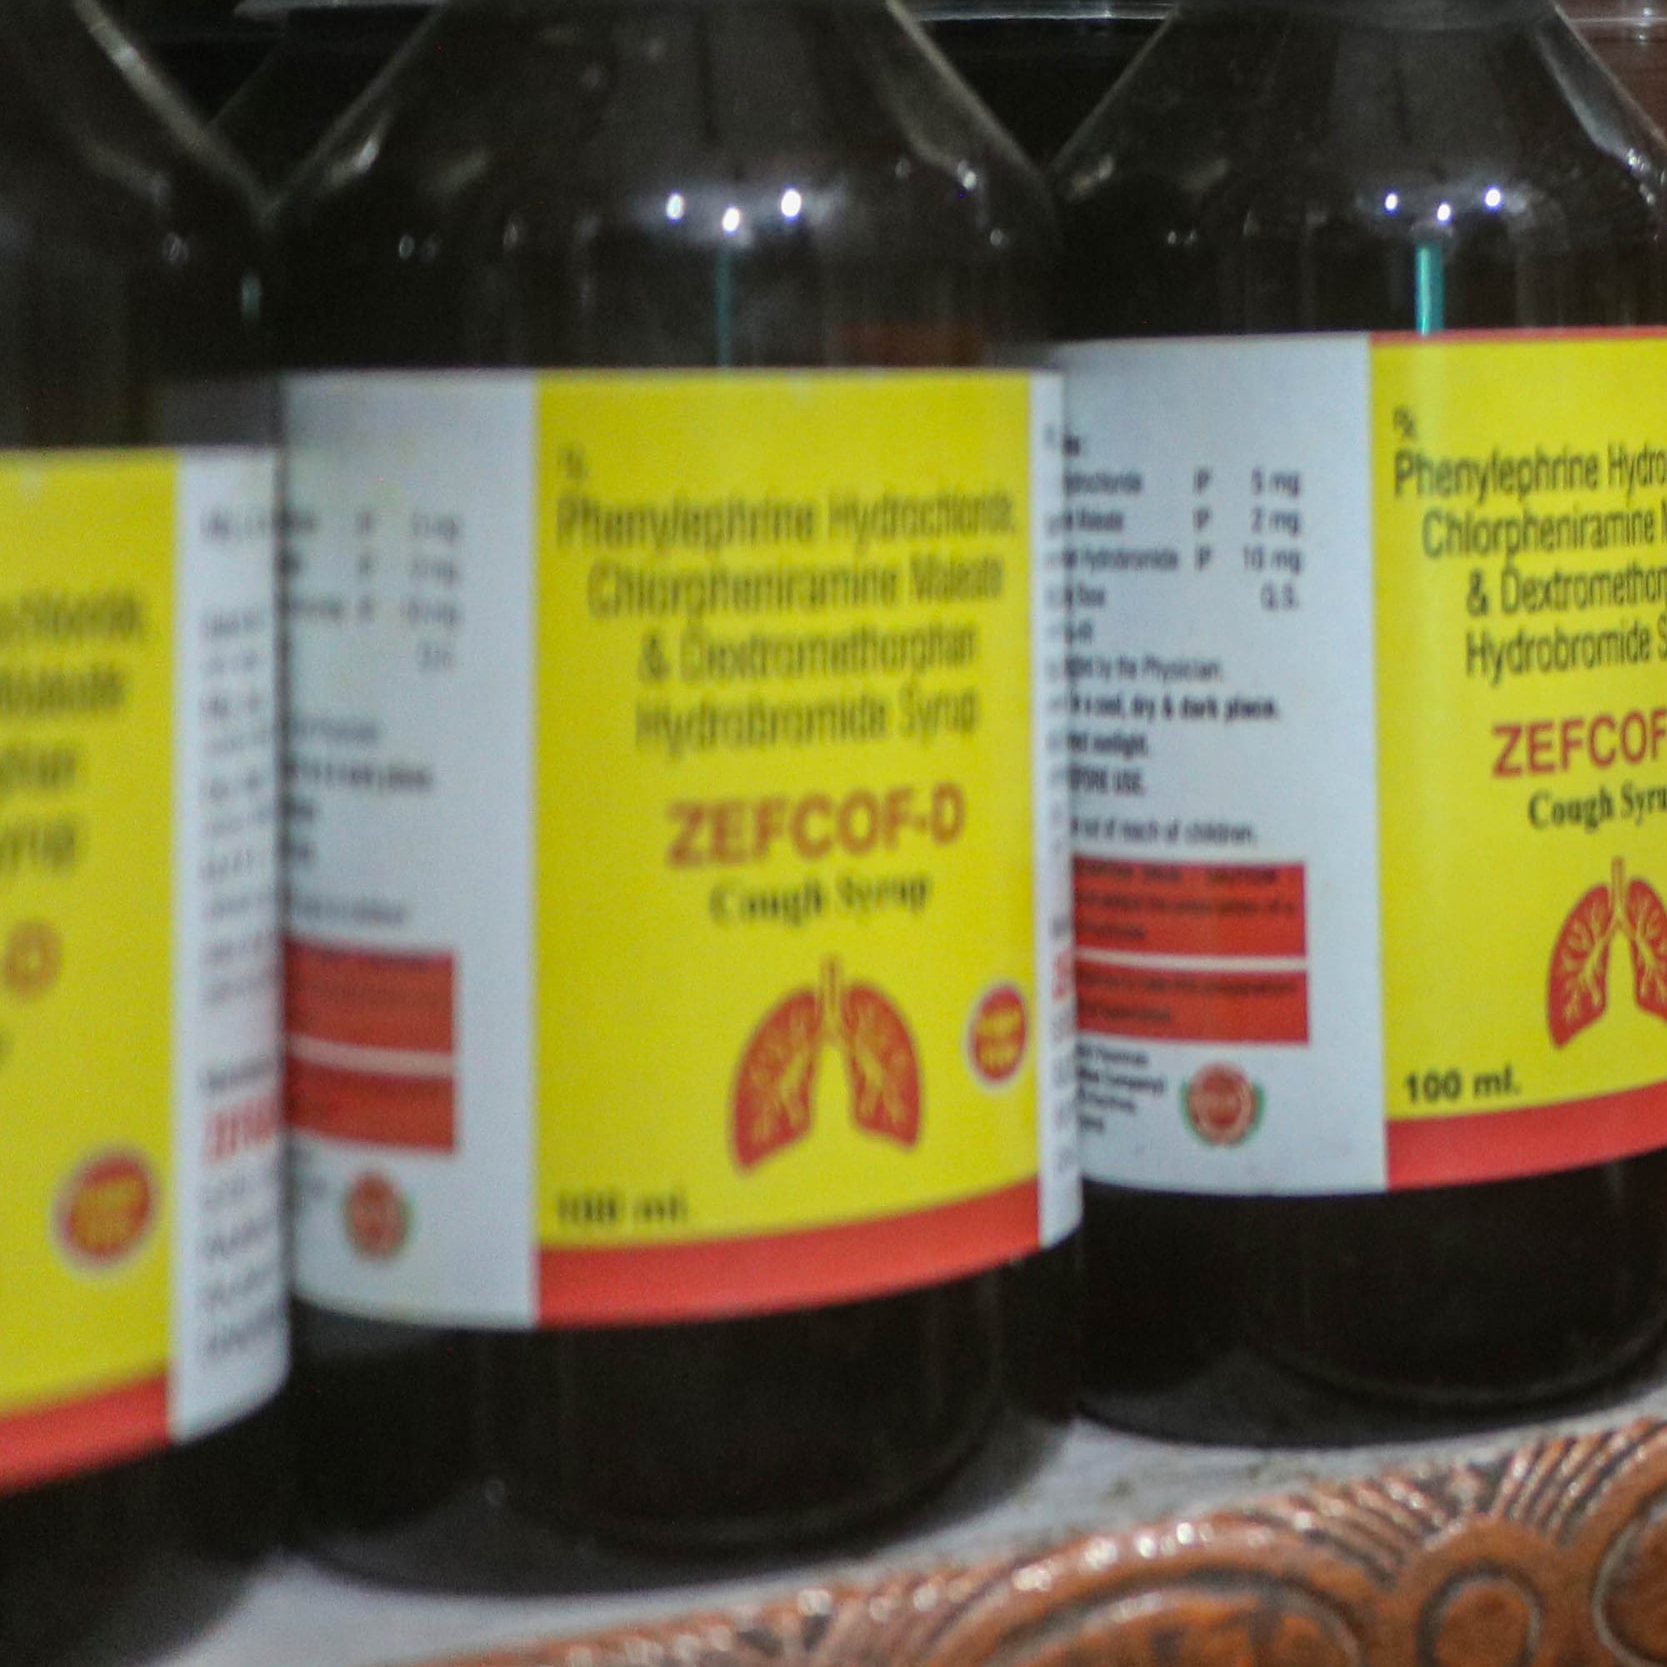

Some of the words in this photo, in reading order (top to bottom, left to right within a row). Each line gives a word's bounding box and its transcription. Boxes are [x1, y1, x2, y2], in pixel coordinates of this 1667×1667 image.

[1394, 444, 1600, 506] Phenylephrine
[1422, 504, 1655, 561] Chlorpheniramine
[1466, 568, 1489, 617] &
[1466, 622, 1651, 685] Hydrobromide
[667, 782, 967, 870] ZEFCOF-D
[1528, 785, 1614, 831] Cough
[1405, 1071, 1462, 1103] 100
